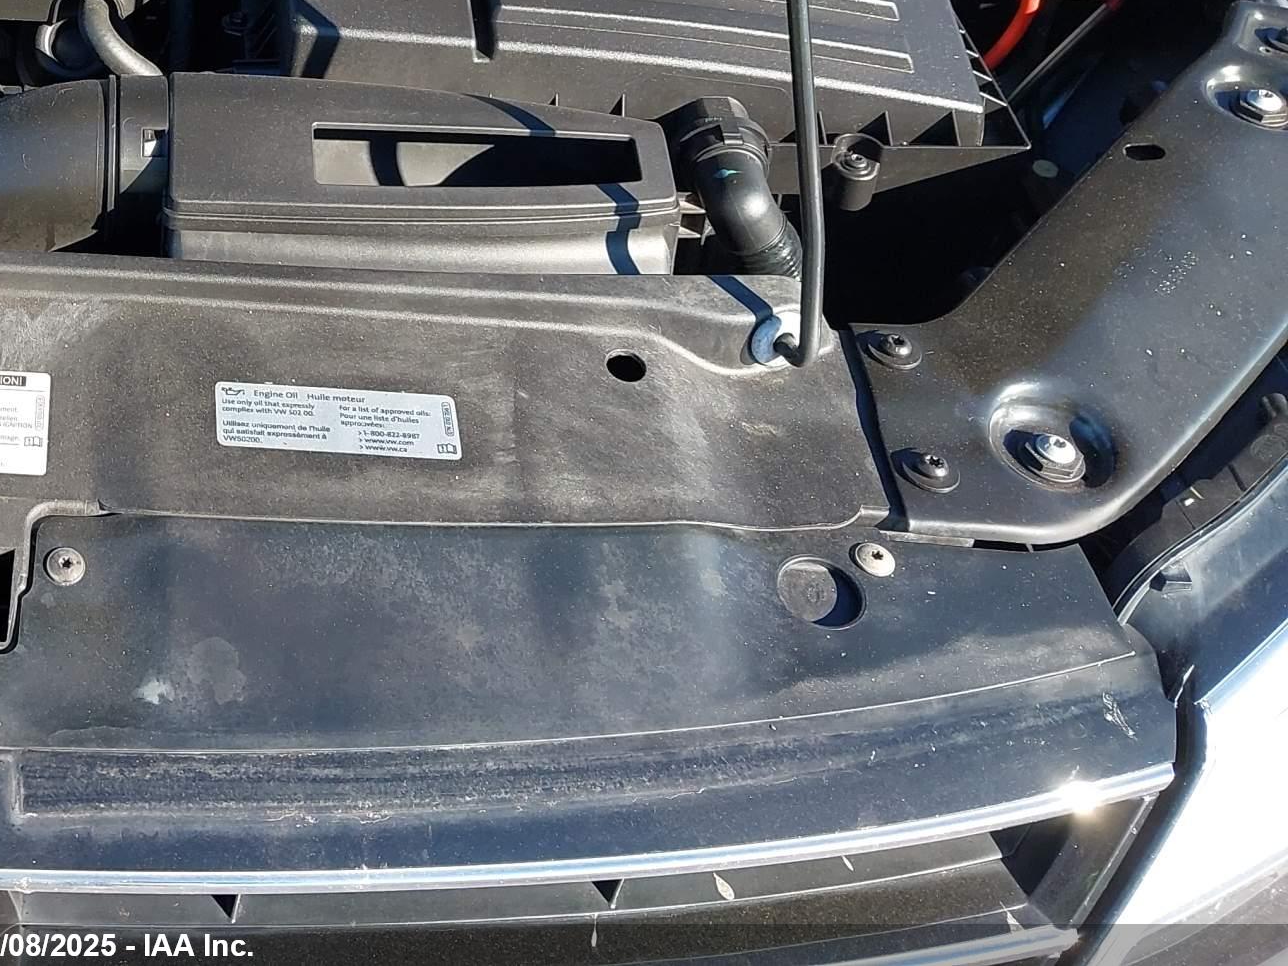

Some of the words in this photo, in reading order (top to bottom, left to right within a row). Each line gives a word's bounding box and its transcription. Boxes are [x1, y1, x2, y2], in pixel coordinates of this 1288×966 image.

[253, 390, 283, 399] Engine
[332, 394, 365, 403] moteur
[222, 405, 253, 413] complies
[281, 402, 315, 410] expressly
[380, 408, 414, 416] approved
[251, 422, 296, 431] uniquement
